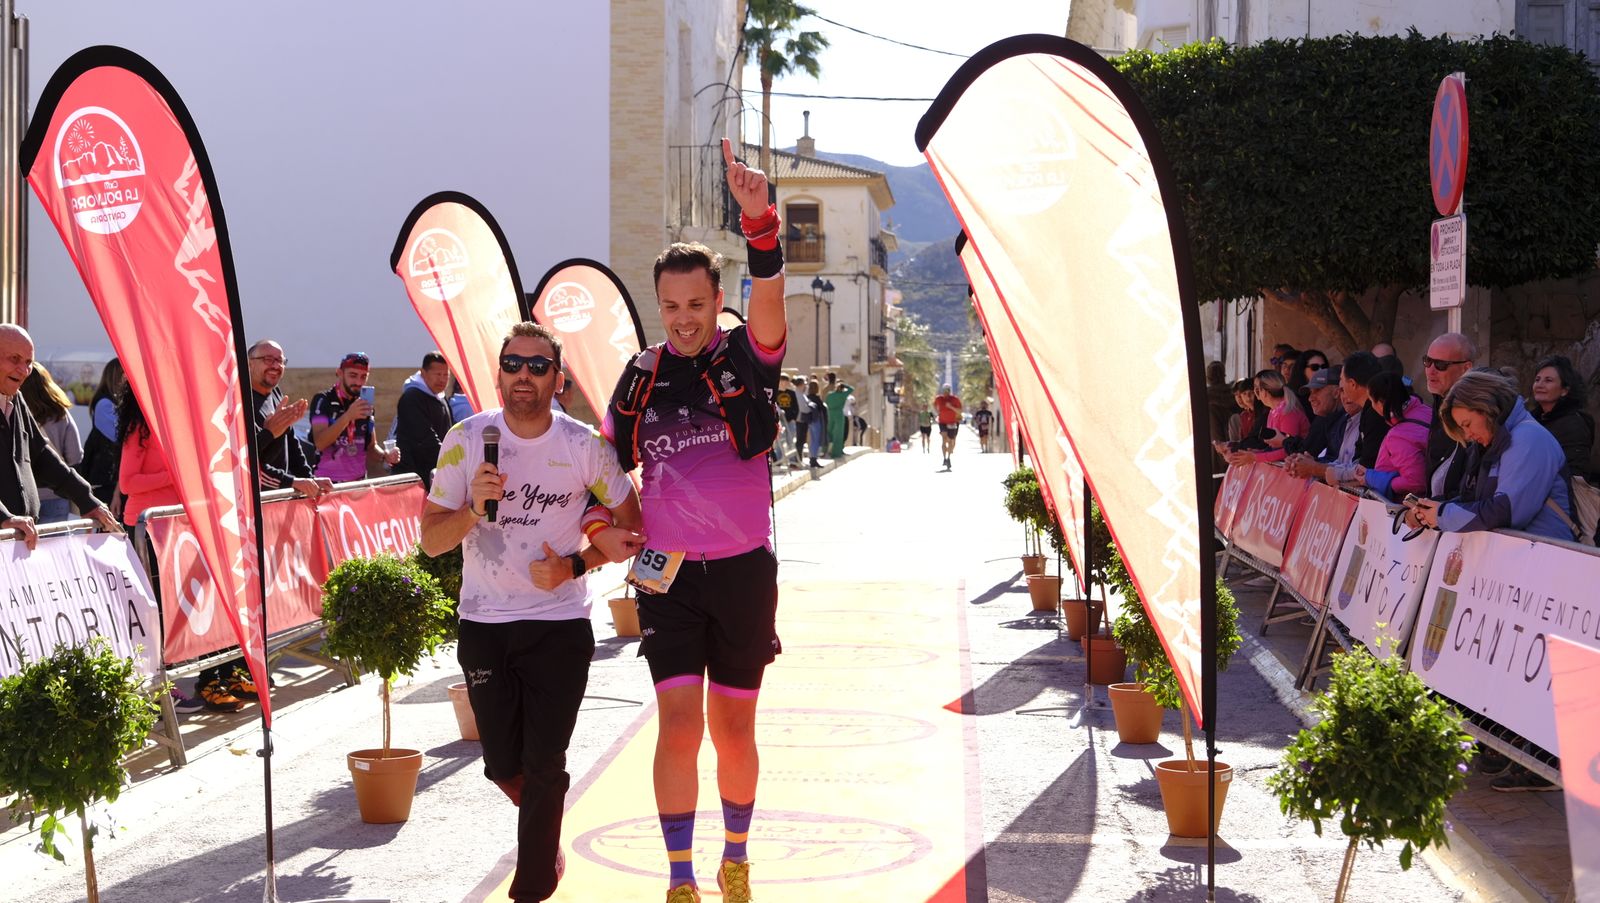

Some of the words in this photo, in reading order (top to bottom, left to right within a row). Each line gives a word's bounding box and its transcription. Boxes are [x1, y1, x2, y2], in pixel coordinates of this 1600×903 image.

[520, 483, 572, 513] Yepes
[499, 513, 541, 529] speaker
[105, 569, 132, 592] DE
